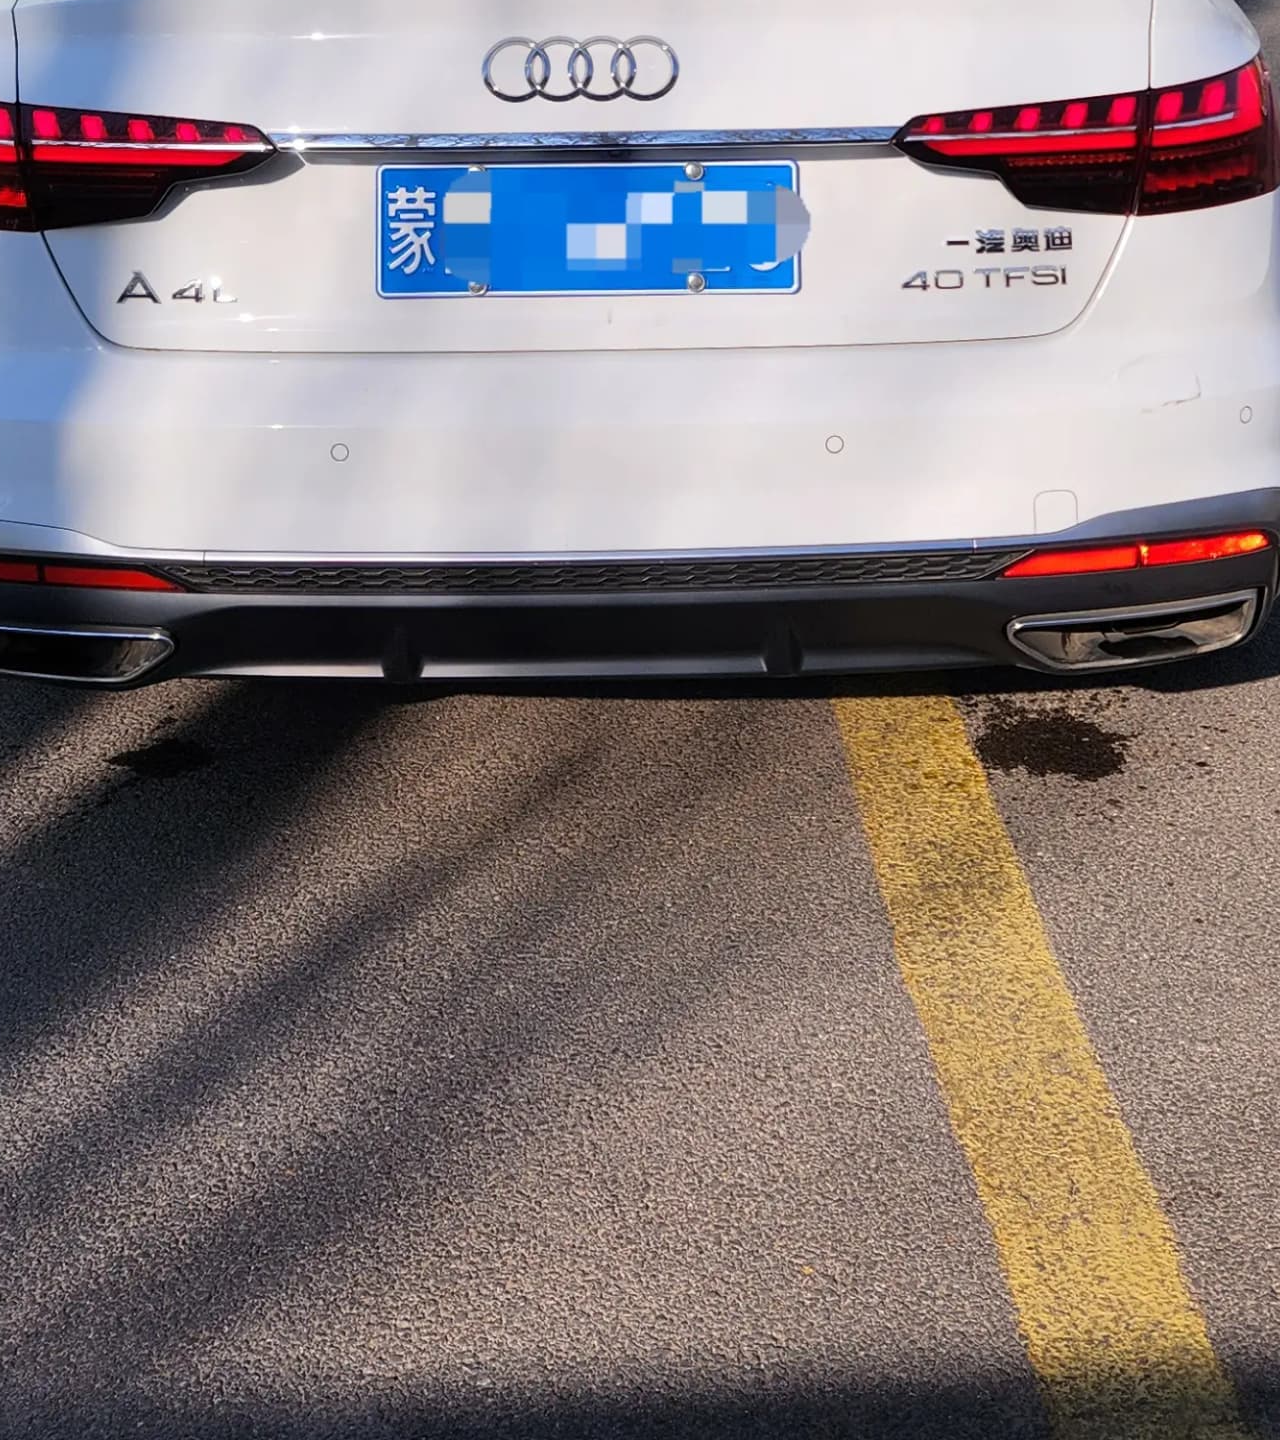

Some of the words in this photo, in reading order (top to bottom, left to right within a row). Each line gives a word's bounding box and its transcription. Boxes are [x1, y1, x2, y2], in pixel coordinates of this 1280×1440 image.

[946, 227, 1072, 253] 一汽奥迪
[902, 270, 964, 291] 40
[974, 265, 1067, 288] TFSI
